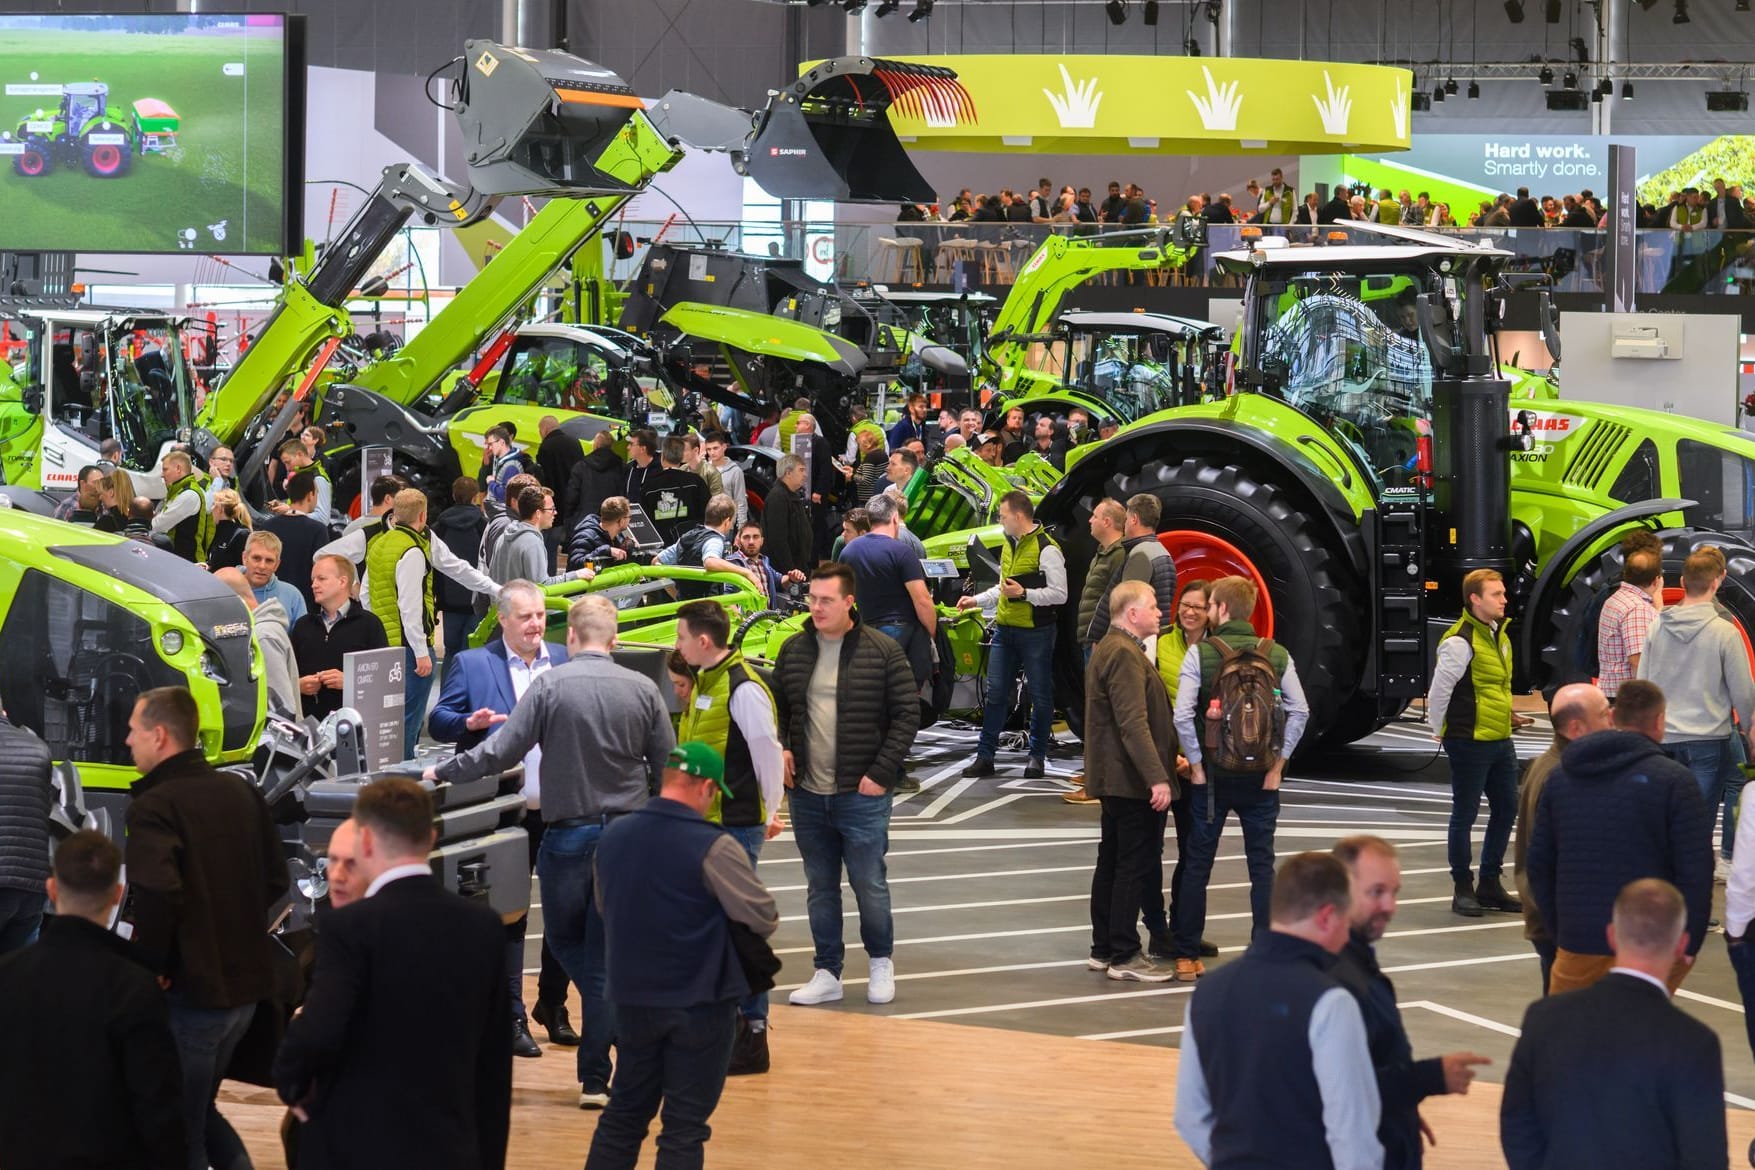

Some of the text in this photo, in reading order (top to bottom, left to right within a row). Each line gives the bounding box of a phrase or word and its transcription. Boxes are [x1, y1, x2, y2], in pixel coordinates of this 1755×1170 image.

[1484, 143, 1591, 158] Hard work.
[1484, 160, 1602, 178] Smartly done.
[1511, 418, 1570, 430] CAAS
[1510, 453, 1548, 462] AXION
[47, 473, 79, 481] CLAAS
